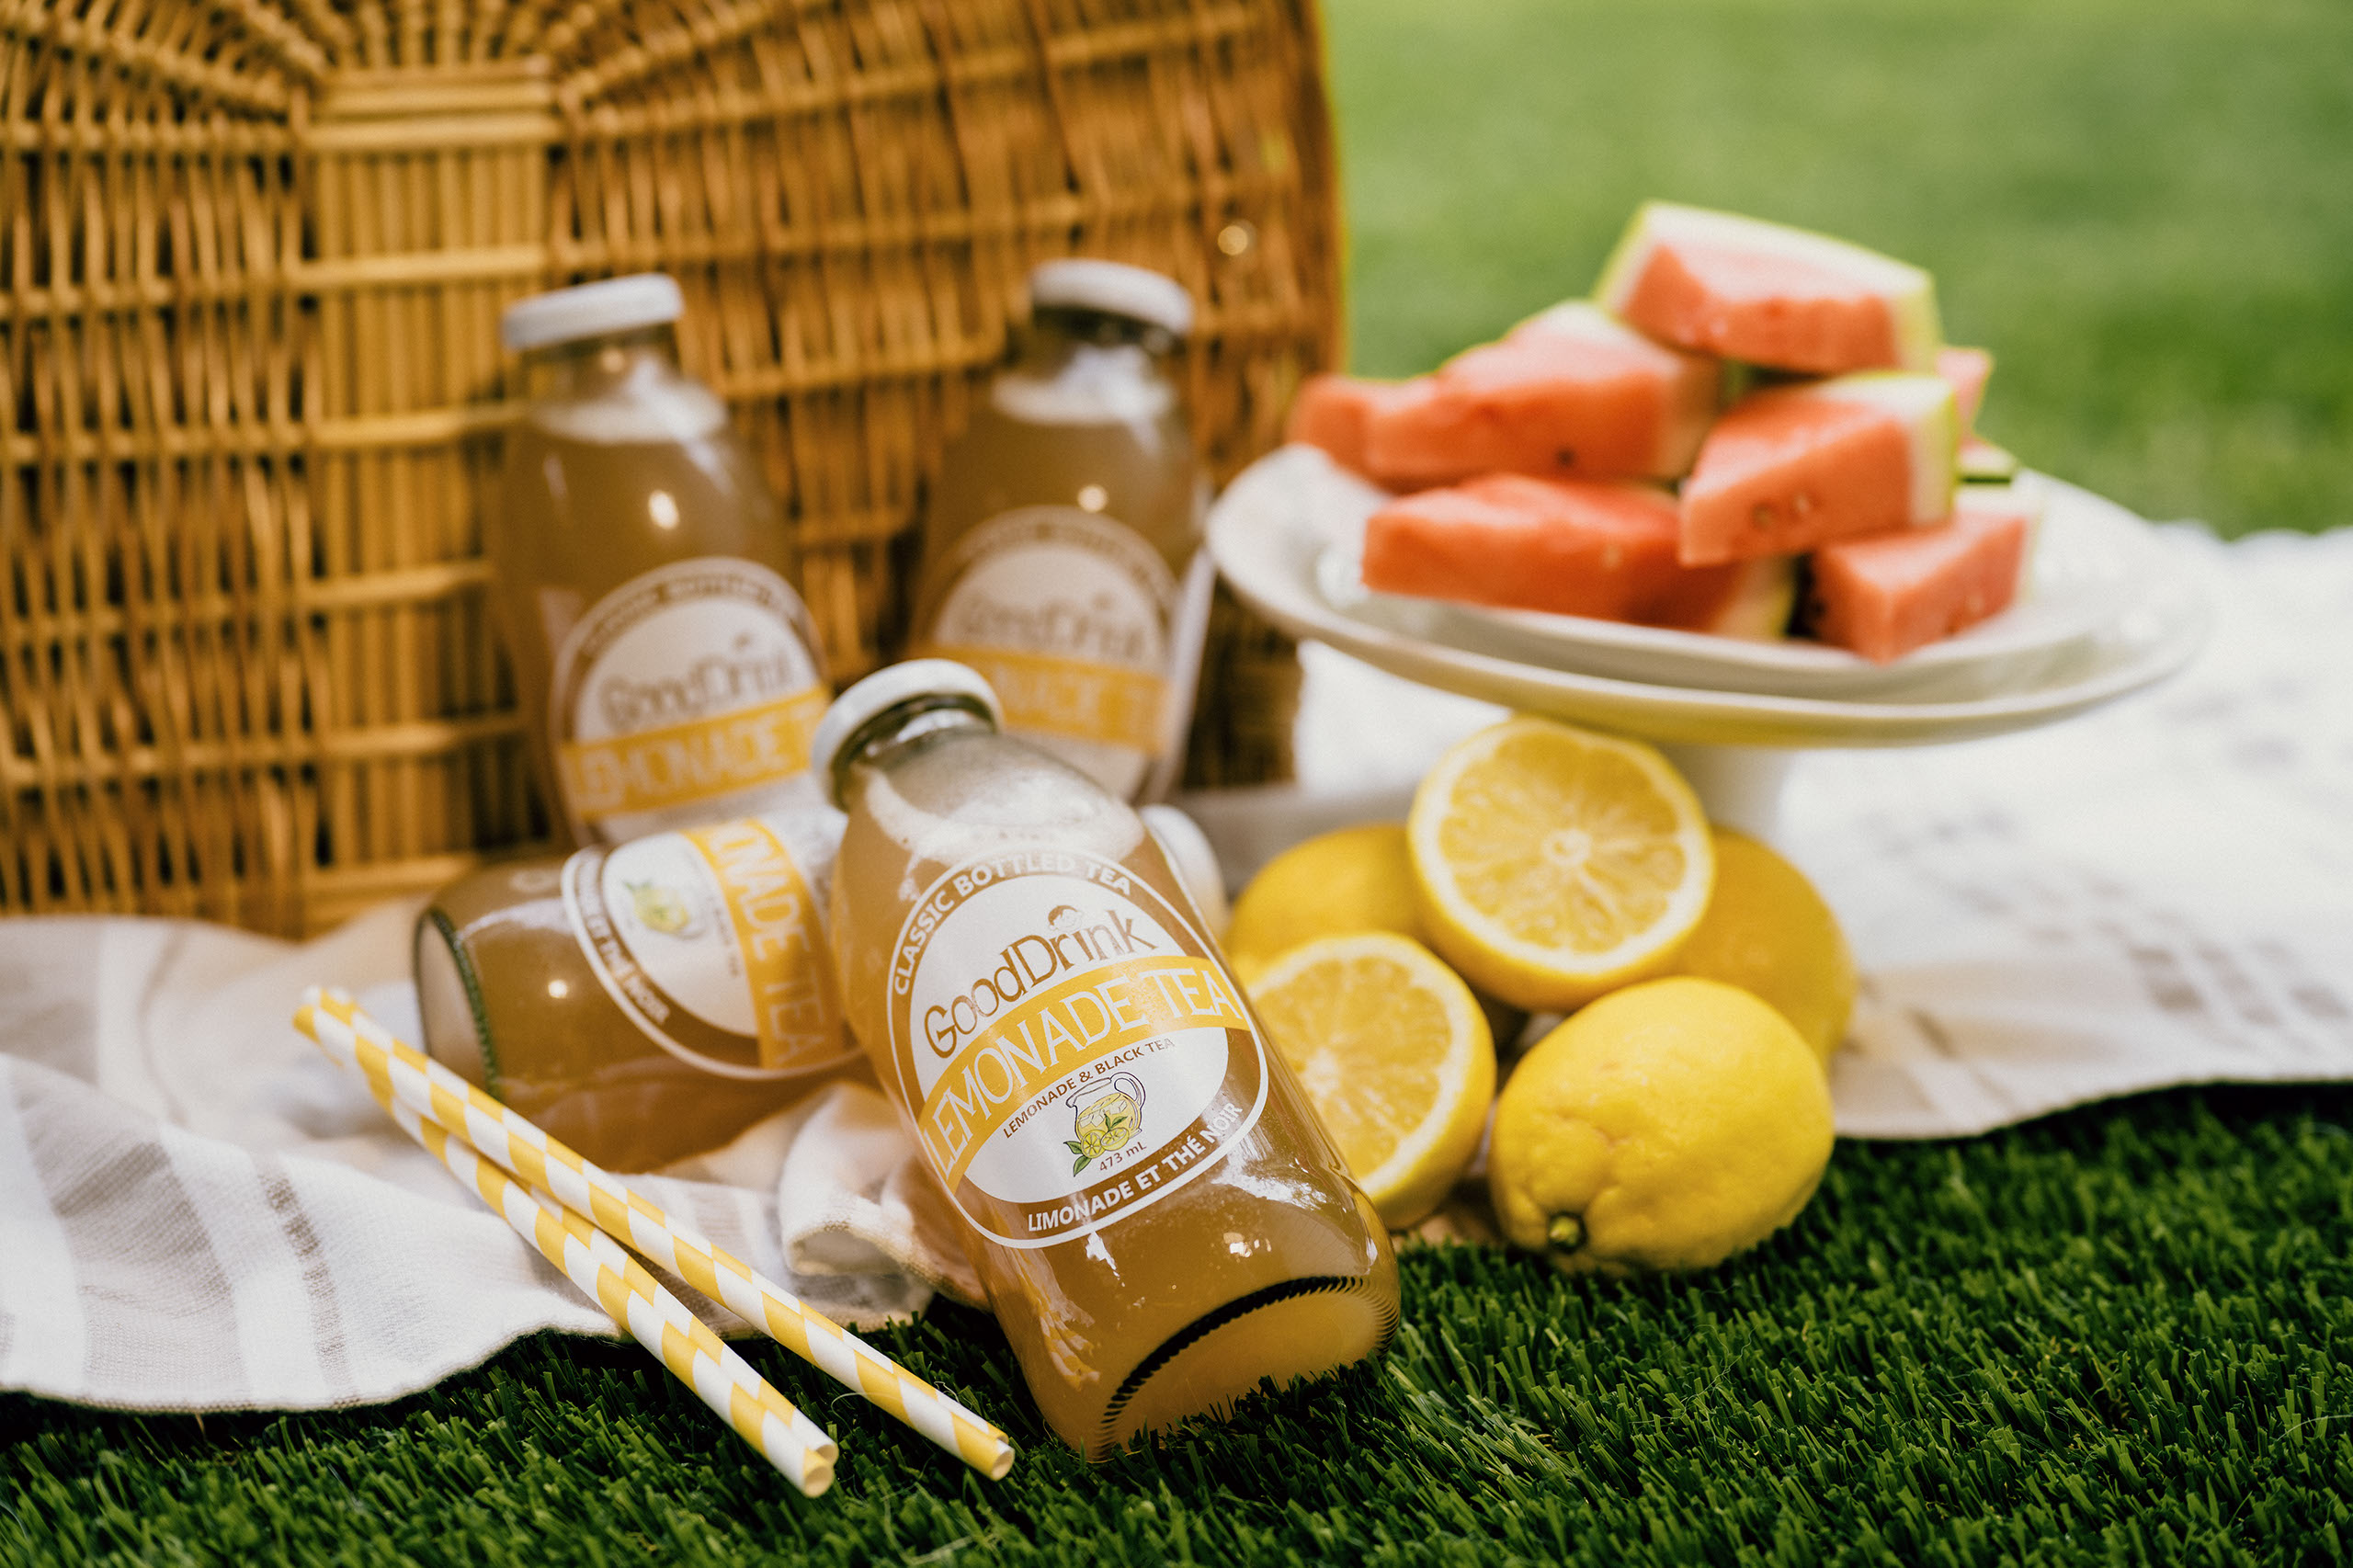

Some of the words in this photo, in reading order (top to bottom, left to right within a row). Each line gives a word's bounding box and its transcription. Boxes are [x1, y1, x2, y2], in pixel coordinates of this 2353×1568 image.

[894, 891, 954, 994] CLASSIC
[952, 853, 1075, 897] BOTTLED
[1086, 861, 1131, 896] TEA
[924, 908, 1159, 1059] GoodDrink
[923, 975, 1149, 1177] LEMONADE
[1136, 967, 1244, 1020] TEA
[1003, 1077, 1077, 1139] LEMONADE
[1079, 1071, 1094, 1084] &
[1094, 1048, 1144, 1075] BLACK
[1144, 1037, 1176, 1053] TEA
[1028, 1180, 1135, 1232] LIMONADE
[1135, 1165, 1163, 1190] ET
[1161, 1135, 1206, 1172] THÉ
[1199, 1101, 1243, 1143] NOIR
[1098, 1153, 1123, 1172] 473
[1126, 1140, 1147, 1157] mL
